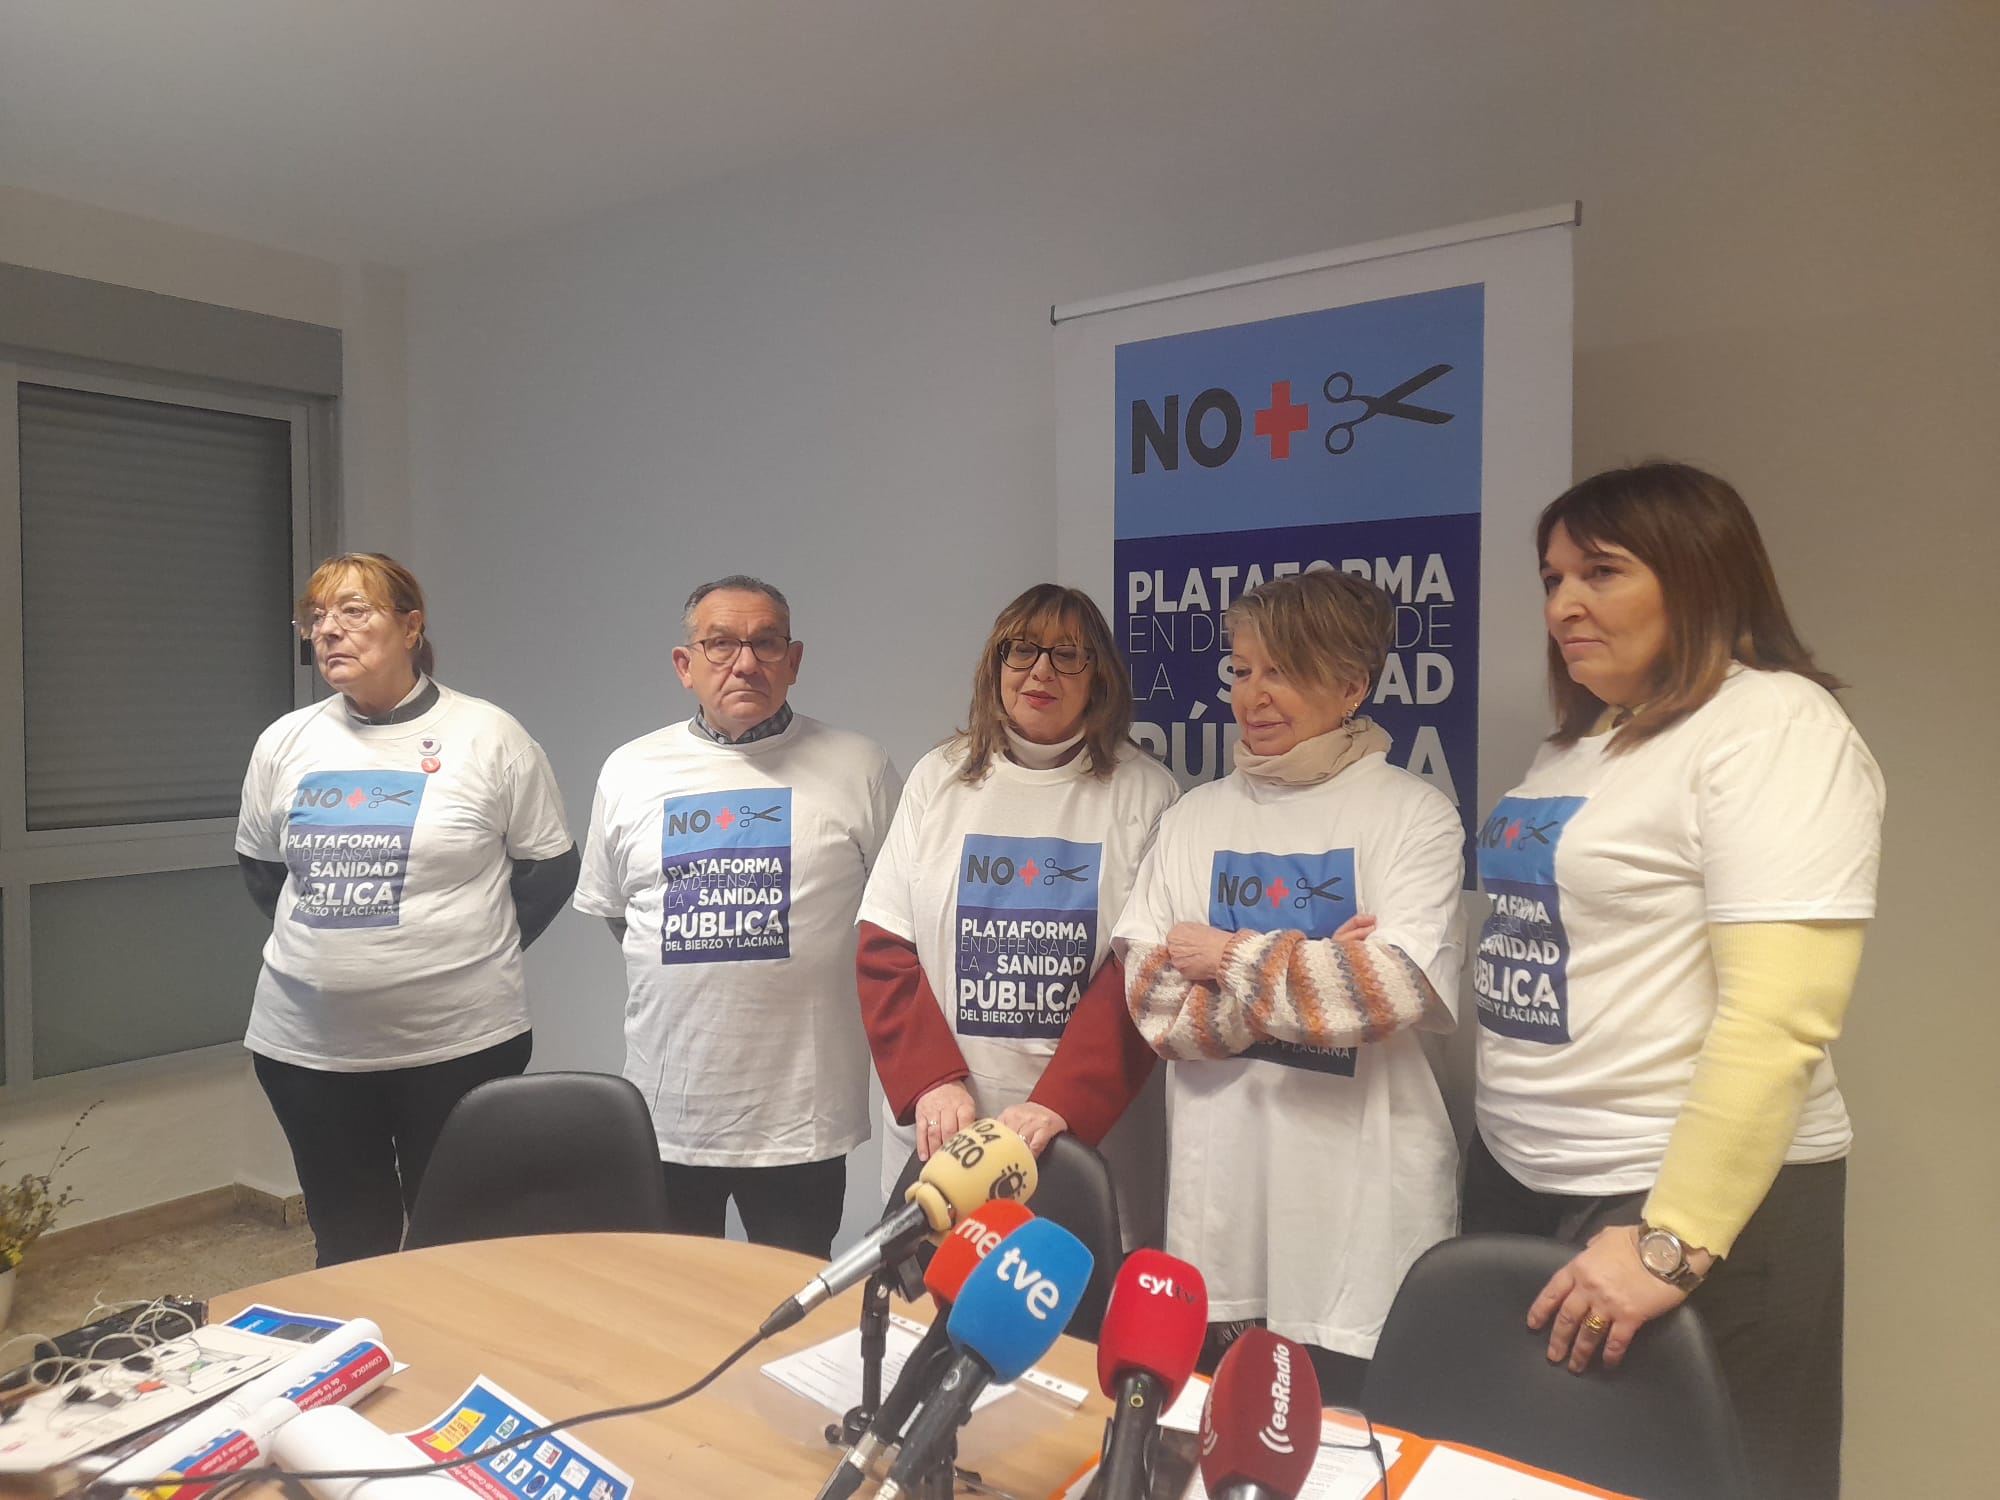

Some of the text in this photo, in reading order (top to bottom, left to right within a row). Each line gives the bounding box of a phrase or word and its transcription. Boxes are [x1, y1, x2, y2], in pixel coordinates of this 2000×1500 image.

[1132, 388, 1242, 474] NO
[1129, 615, 1175, 653] EN
[298, 787, 343, 808] NO
[668, 809, 711, 837] NO
[287, 833, 402, 850] PLATAFORMA
[302, 848, 374, 862] DEFENSA
[309, 861, 399, 878] SANIDAD
[667, 857, 783, 881] PLATAFORMA
[967, 855, 1015, 885] NO
[670, 872, 782, 893] EN DEFENSA DE
[1217, 872, 1263, 907] NO
[668, 887, 783, 909] LA SANIDAD
[342, 905, 394, 917] LACIANA
[665, 905, 784, 940] PÚBLICA
[961, 918, 1088, 940] PLATAFORMA
[665, 935, 784, 952] DEL BIERZO Y LACIANA
[960, 936, 1087, 957] EN DEFENSA DE
[960, 954, 1086, 976] LA SANIDAD
[959, 972, 1081, 1011] PÚBLICA
[960, 1008, 1073, 1025] DEL BIERZO Y LACIA
[1493, 1003, 1502, 1020] Y
[1503, 1005, 1560, 1027] LACIANA
[997, 1247, 1060, 1320] tve
[1271, 1342, 1292, 1431] esRadio
